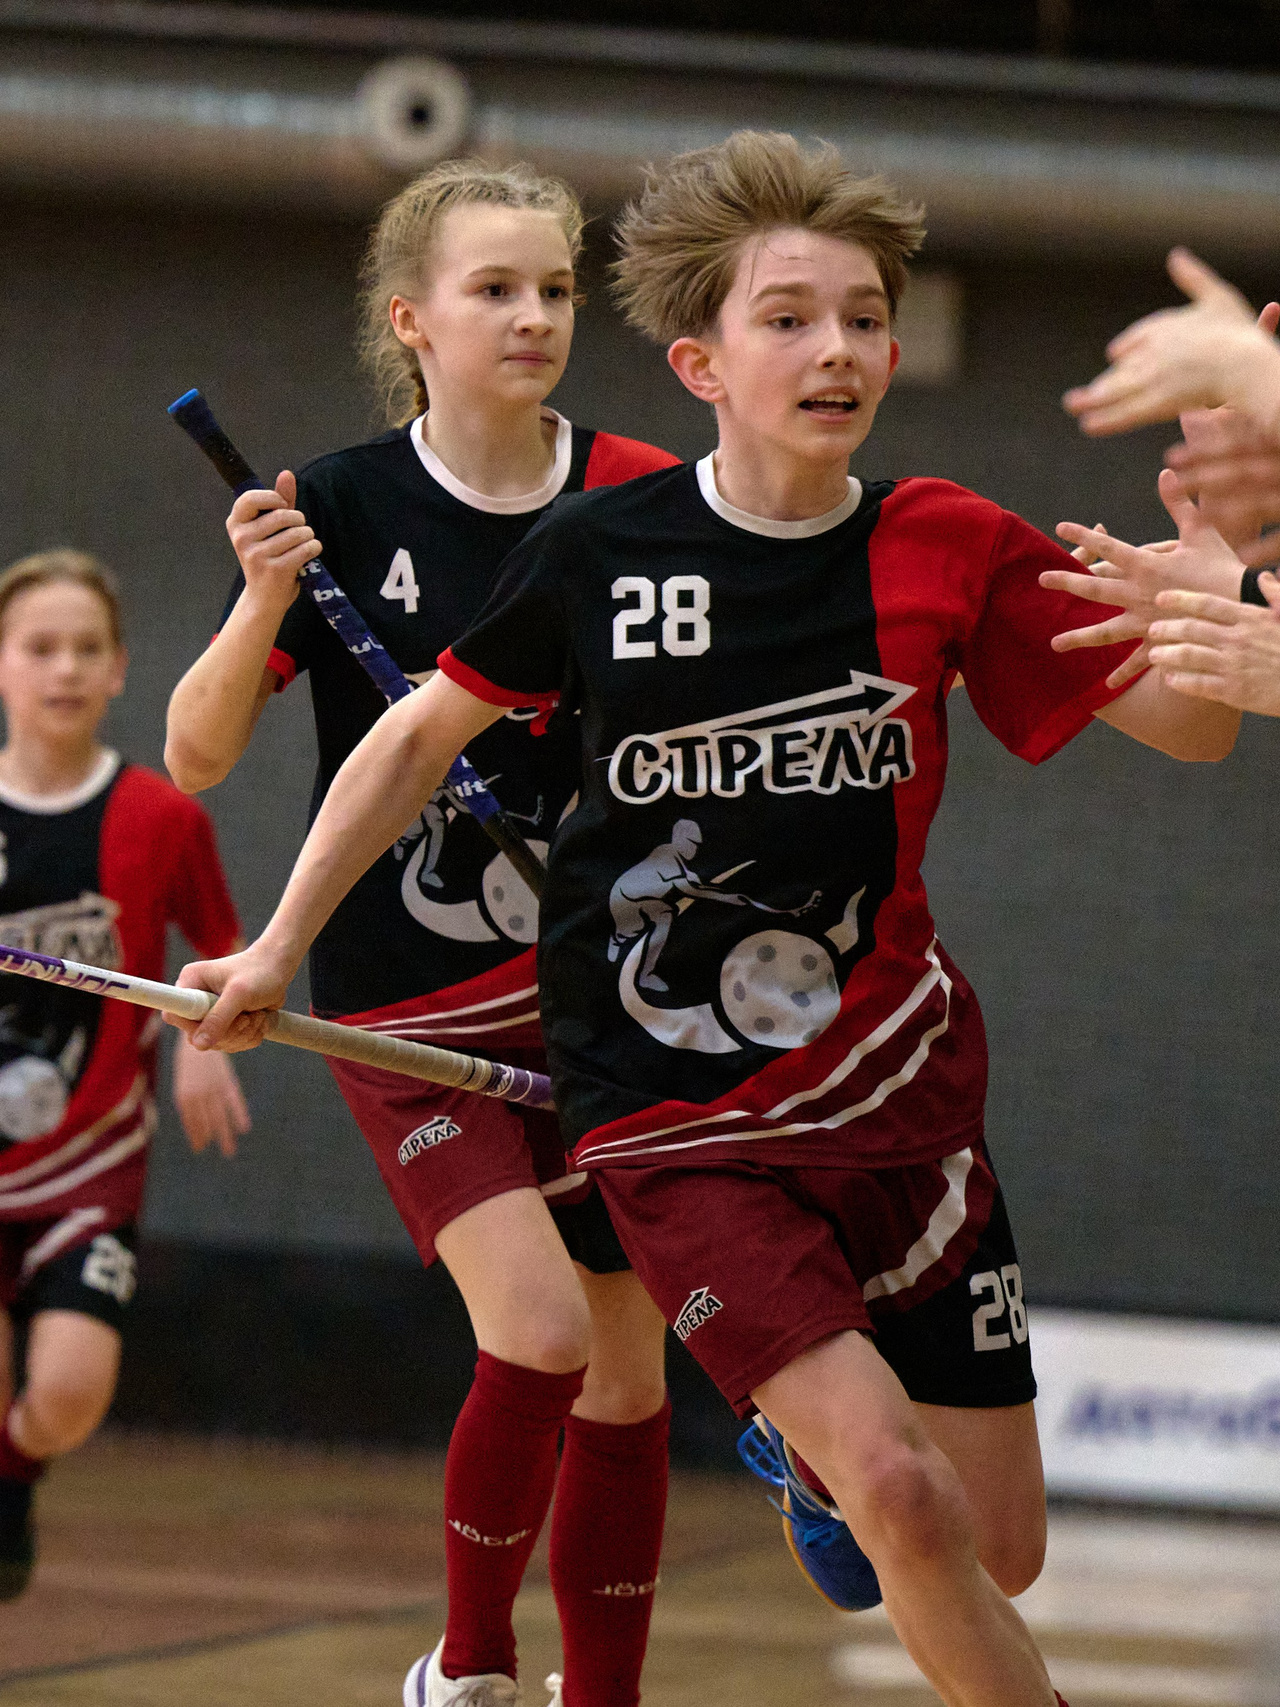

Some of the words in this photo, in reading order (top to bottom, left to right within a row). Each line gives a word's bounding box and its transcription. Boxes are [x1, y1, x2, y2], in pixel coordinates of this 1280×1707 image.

[380, 547, 420, 614] 4
[611, 575, 711, 660] 28
[608, 717, 917, 805] СТРЕЛА
[397, 1120, 462, 1166] СТРЕЛА
[675, 1294, 724, 1342] ТРЕЛА
[968, 1262, 1029, 1353] 28
